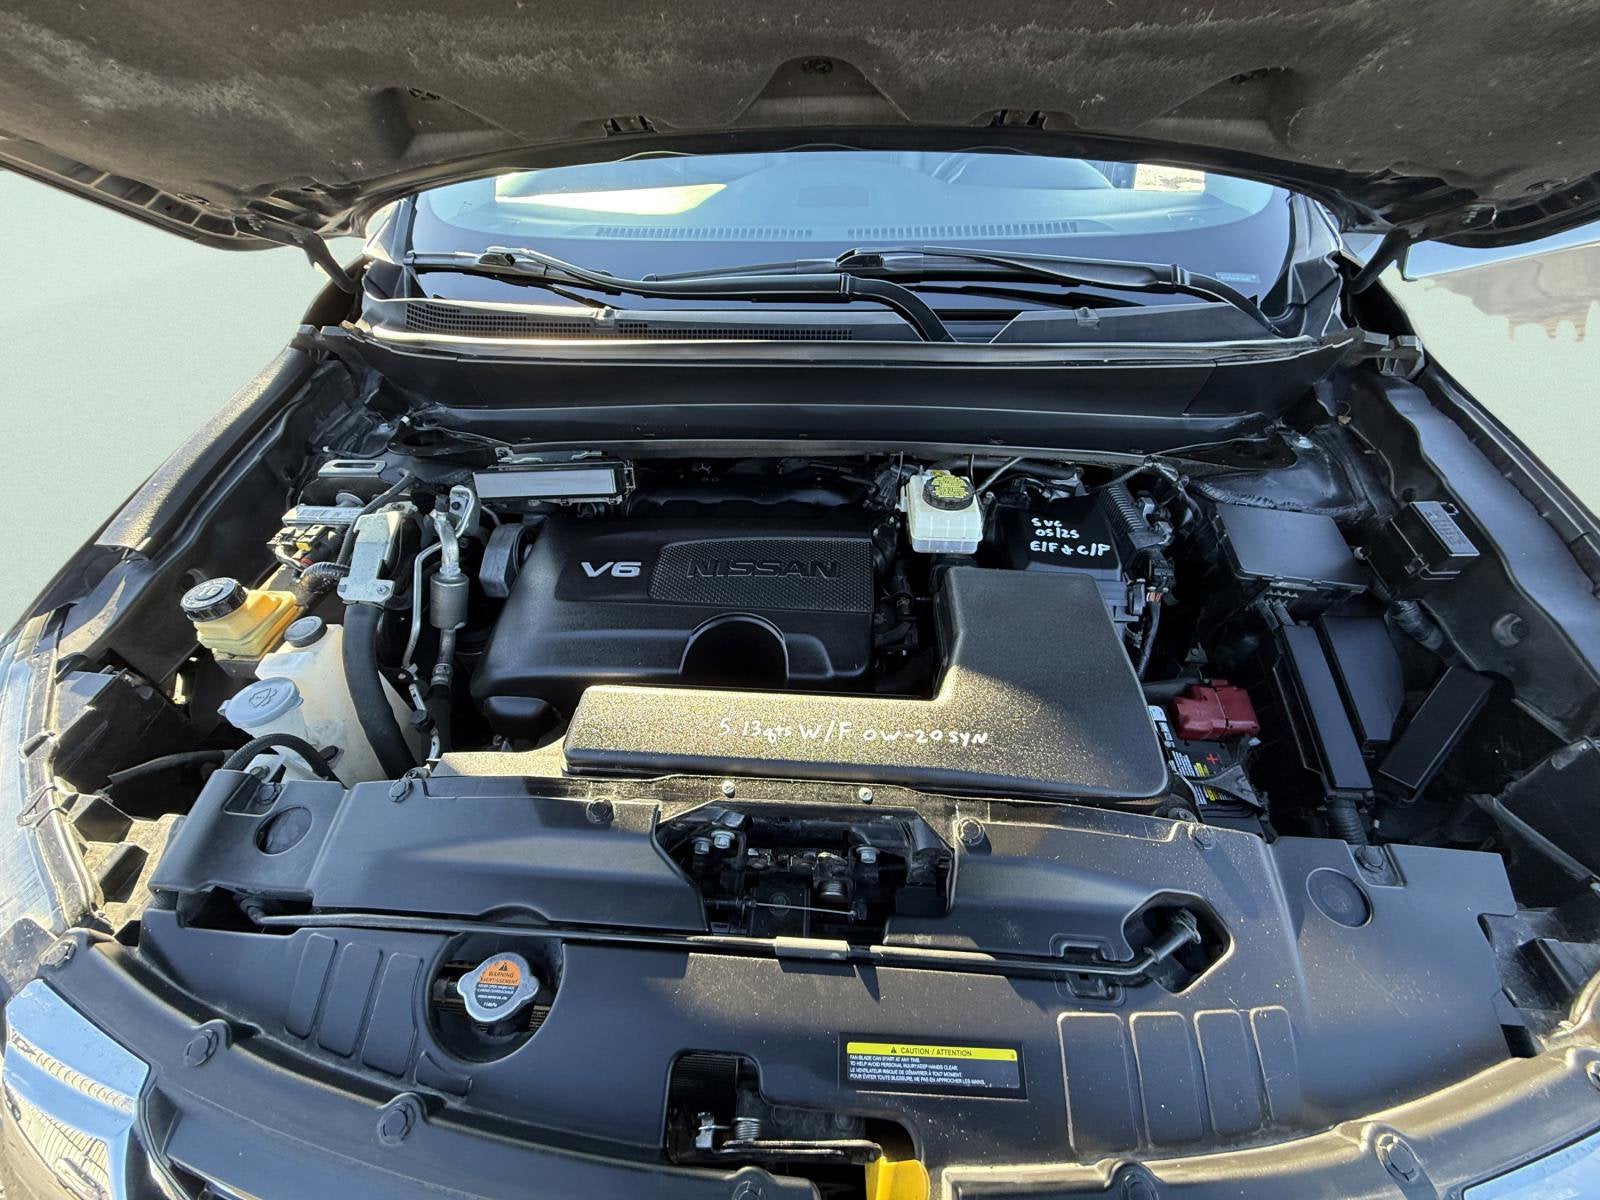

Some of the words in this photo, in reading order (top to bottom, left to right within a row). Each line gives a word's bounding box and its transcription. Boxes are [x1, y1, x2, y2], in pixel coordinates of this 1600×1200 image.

[581, 561, 642, 577] V6
[686, 560, 840, 579] NISSAN
[901, 1047, 930, 1055] CAUTION
